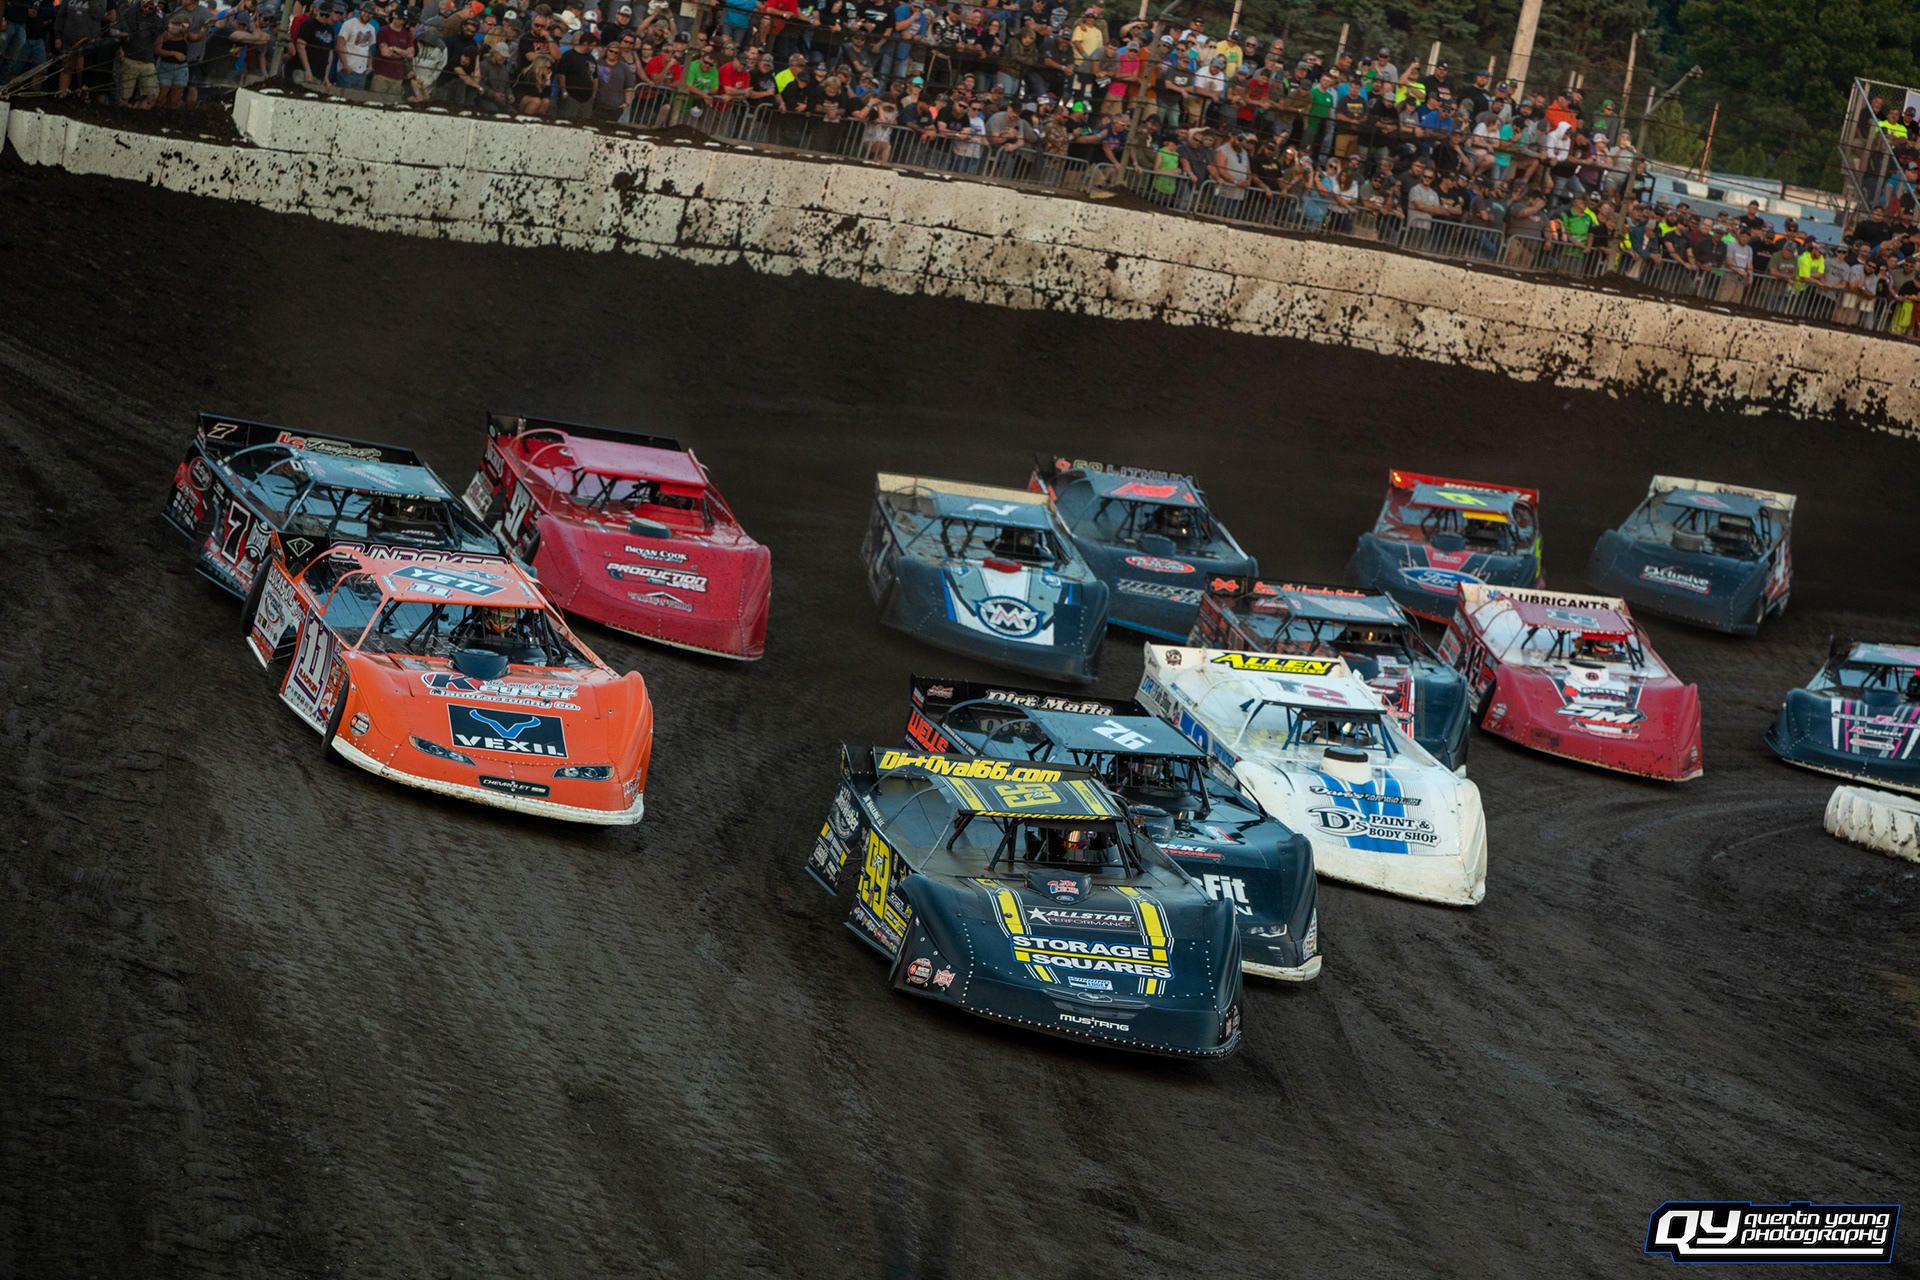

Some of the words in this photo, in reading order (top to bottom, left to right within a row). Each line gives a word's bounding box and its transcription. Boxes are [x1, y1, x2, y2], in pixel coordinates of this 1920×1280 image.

[206, 421, 241, 440] 7
[1106, 464, 1193, 482] LITHIUM
[221, 499, 251, 565] 7
[624, 544, 658, 557] BRYAN
[659, 550, 689, 562] COOK
[410, 568, 492, 593] YETI
[605, 562, 709, 586] PRODUCTION
[1510, 593, 1610, 610] LUBRICANTS
[1212, 653, 1332, 672] ALLEN
[986, 690, 1040, 707] Dirt
[1041, 696, 1113, 716] Mafia
[908, 711, 949, 753] WELLS
[1092, 719, 1152, 750] 76
[878, 750, 1062, 783] DirtOval66.com
[483, 779, 531, 791] CHEVROLET
[1371, 815, 1415, 828] PAINT
[1418, 820, 1431, 830] &
[1369, 828, 1401, 840] BODY
[1404, 832, 1438, 844] SHOP
[1046, 910, 1133, 922] ALLSTAR
[1012, 935, 1151, 960] STORAGE
[1032, 953, 1173, 979] SQUARES
[1060, 1013, 1130, 1032] MUSTANG
